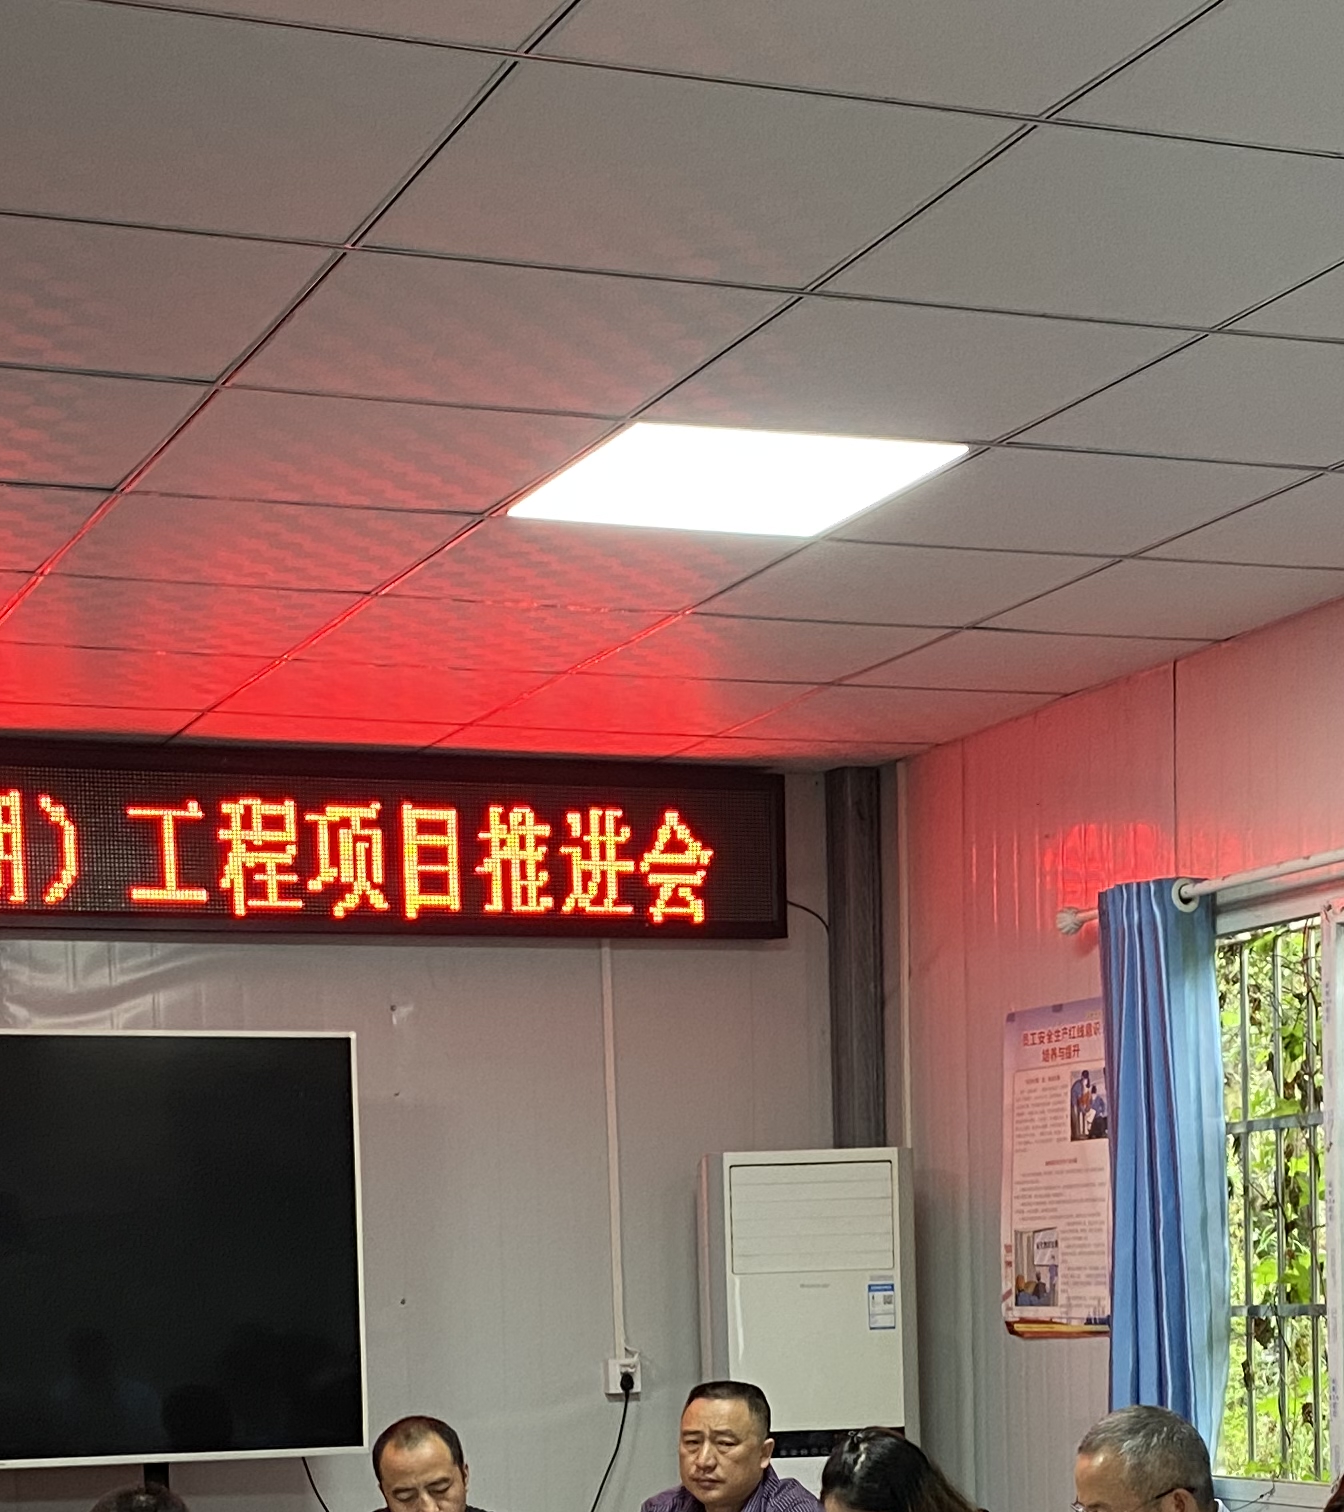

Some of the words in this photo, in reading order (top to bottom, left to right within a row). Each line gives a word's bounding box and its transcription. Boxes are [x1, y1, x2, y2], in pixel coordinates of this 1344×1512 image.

[1022, 1021, 1102, 1047] 员工安全生产红线意识
[1042, 1044, 1081, 1063] 培养与提升
